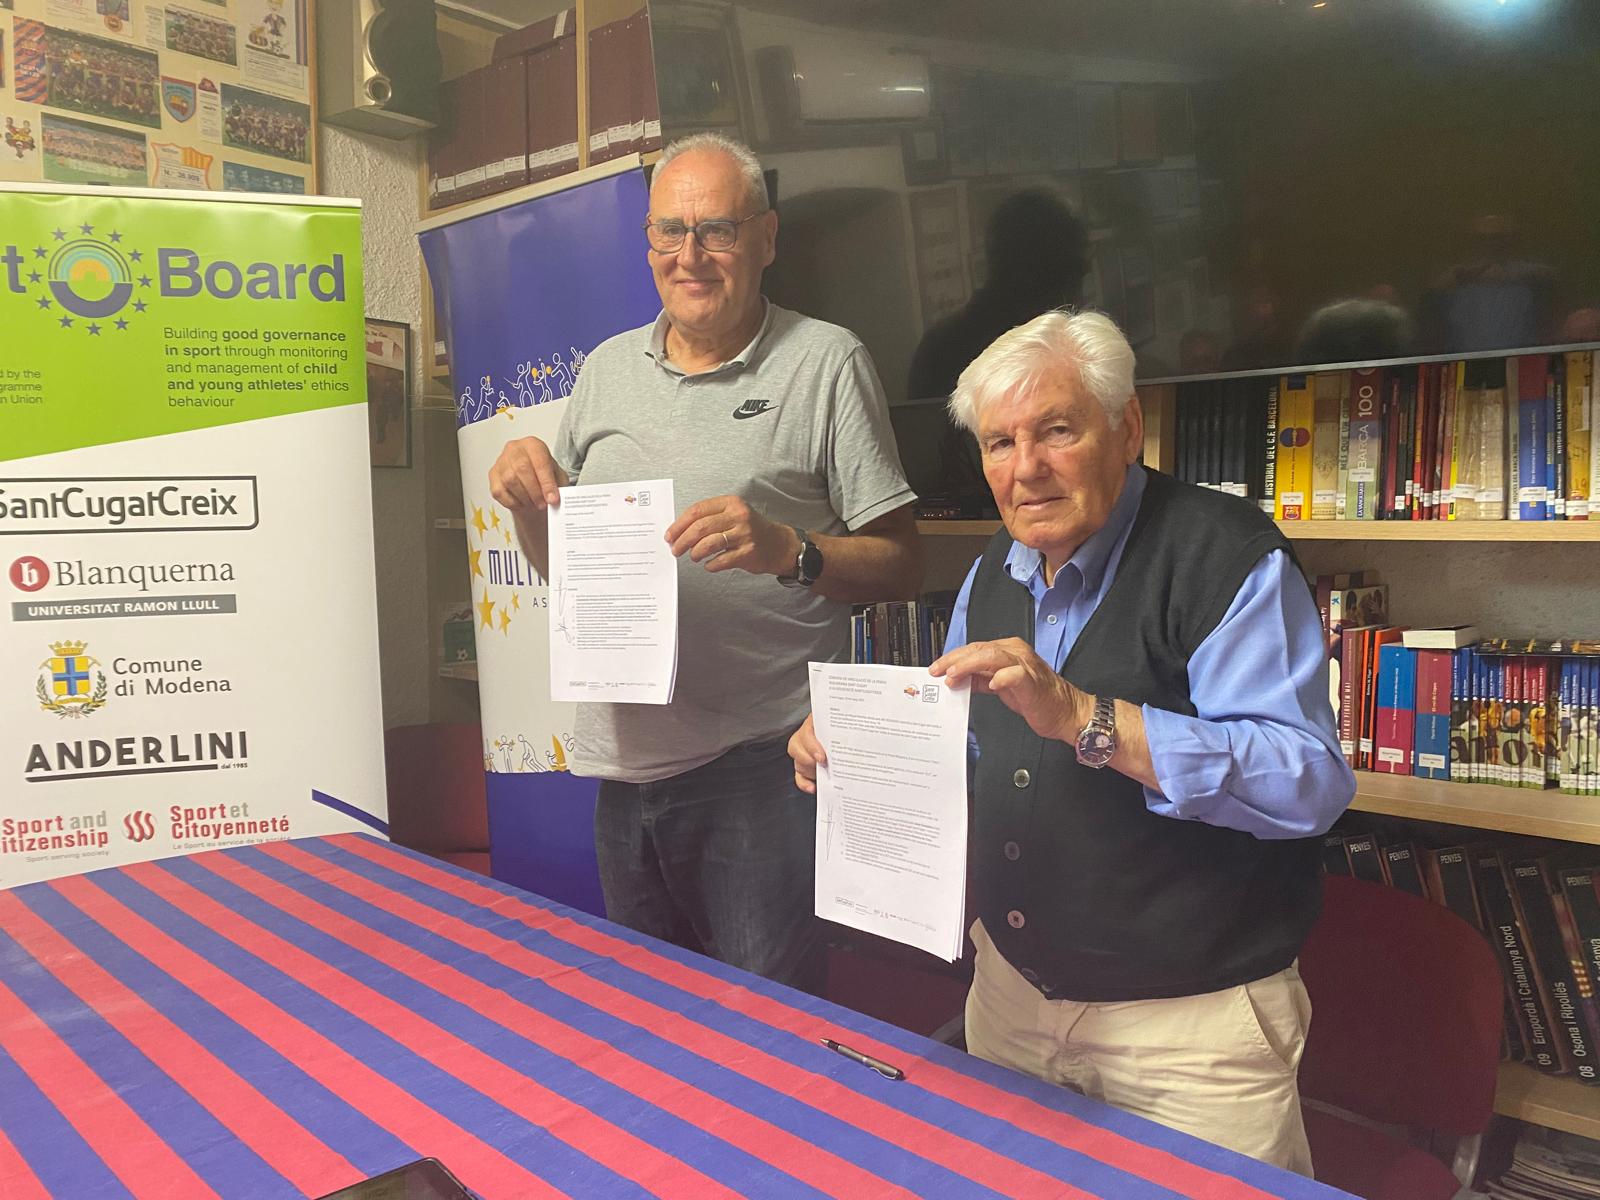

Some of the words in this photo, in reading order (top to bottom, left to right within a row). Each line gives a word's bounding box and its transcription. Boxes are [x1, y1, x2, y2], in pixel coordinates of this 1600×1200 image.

[157, 247, 346, 302] Board
[164, 327, 217, 342] Building
[222, 328, 258, 342] good
[263, 330, 346, 342] governance
[165, 345, 178, 356] in
[183, 345, 221, 358] sport
[225, 346, 275, 359] through
[280, 347, 348, 361] monitoring
[7, 369, 20, 380] by
[23, 369, 41, 379] the
[166, 362, 191, 373] and
[196, 363, 283, 376] management
[287, 362, 299, 374] of
[303, 363, 337, 375] child
[168, 379, 194, 390] and
[199, 381, 243, 393] young
[248, 379, 307, 391] athletes'
[311, 380, 349, 391] ethics
[10, 394, 43, 404] Union
[168, 396, 235, 407] behaviour
[739, 399, 770, 412] NIKE
[1267, 386, 1278, 429] BARCELONA
[1358, 385, 1373, 418] 100
[1266, 445, 1276, 460] DEL
[1265, 463, 1275, 496] HISTORIA
[54, 558, 236, 592] Blanquerna
[28, 602, 120, 617] UNIVERSITAT
[124, 600, 177, 613] RAMON
[181, 599, 220, 611] LLULL
[113, 657, 203, 675] Comune
[115, 680, 134, 697] di
[146, 676, 231, 696] Modena
[25, 731, 248, 773] ANDERLINI
[170, 804, 226, 825] Sport
[230, 802, 249, 818] et
[2, 815, 64, 837] Sport
[70, 810, 107, 829] and
[171, 816, 290, 839] Citoyenneté
[2, 829, 109, 853] itizenship
[184, 842, 205, 850] Sport
[1349, 841, 1371, 853] PENYES
[25, 855, 49, 863] Sport
[51, 852, 80, 861] serving
[81, 849, 110, 858] society
[1388, 849, 1410, 862] PENYES
[1440, 853, 1462, 864] PENYES
[1514, 866, 1539, 877] PENYES
[1566, 875, 1592, 886] PENYES
[1499, 925, 1517, 948] Nord
[1508, 949, 1532, 996] Catalunya
[1553, 981, 1575, 1019] Ripollès
[1524, 1002, 1546, 1045] Empordà
[1568, 1027, 1588, 1057] Osona
[1537, 1053, 1552, 1066] 09
[1578, 1065, 1596, 1079] 08
